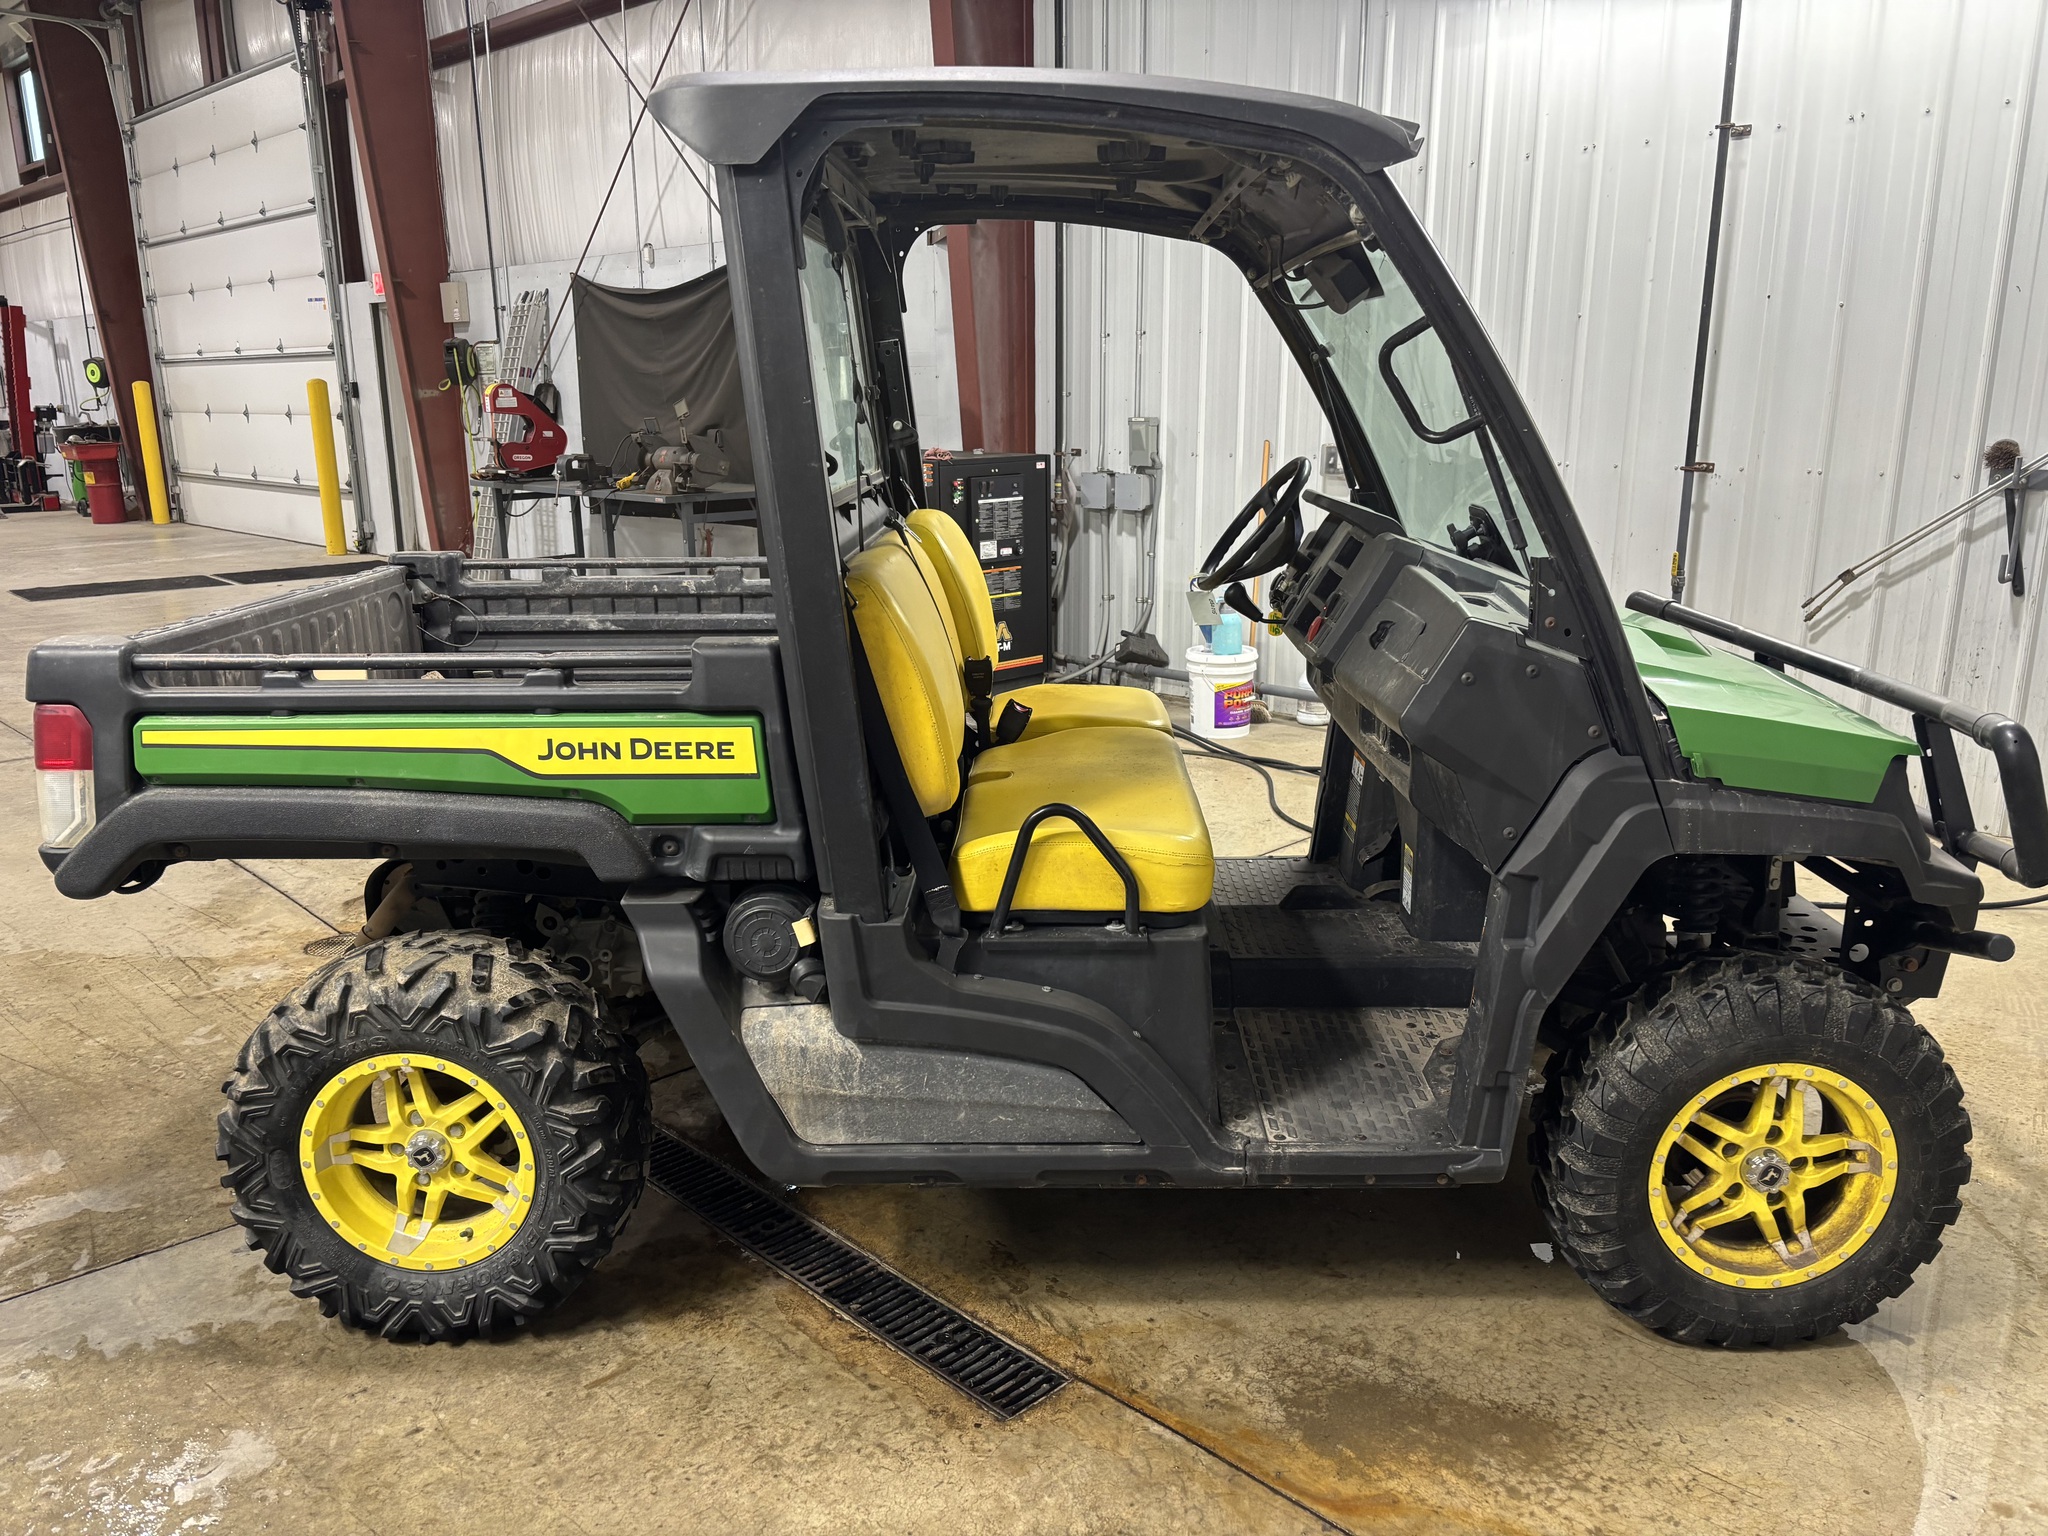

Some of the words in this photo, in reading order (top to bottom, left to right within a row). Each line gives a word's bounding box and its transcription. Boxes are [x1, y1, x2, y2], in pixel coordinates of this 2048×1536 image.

[997, 641, 1011, 651] T-M
[538, 738, 621, 760] JOHN
[630, 738, 735, 760] DEERE
[429, 1226, 547, 1295] BIGHORN
[379, 1272, 428, 1297] 2.0
